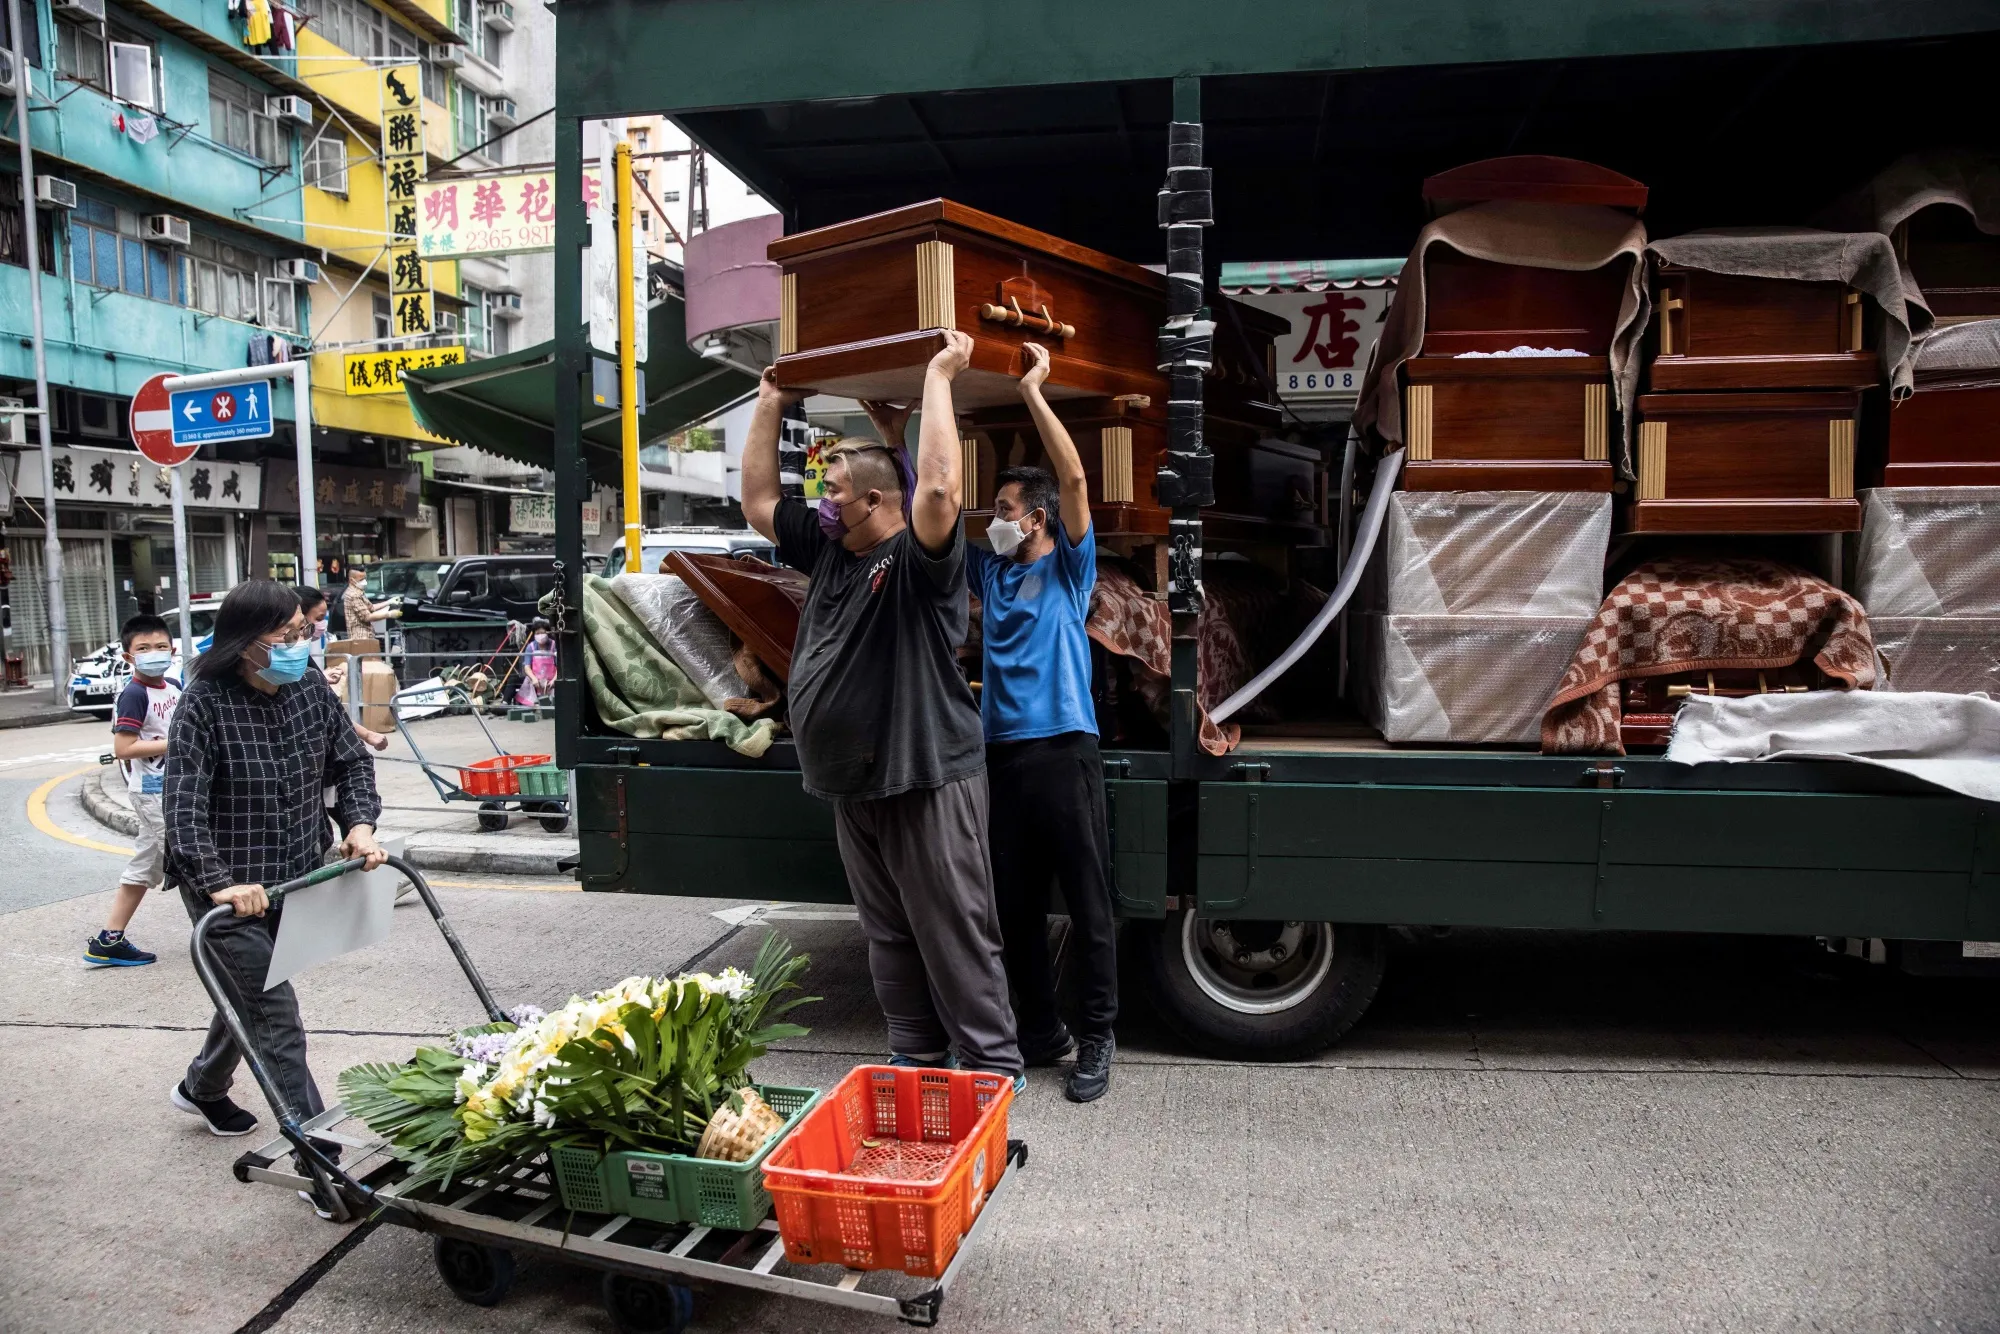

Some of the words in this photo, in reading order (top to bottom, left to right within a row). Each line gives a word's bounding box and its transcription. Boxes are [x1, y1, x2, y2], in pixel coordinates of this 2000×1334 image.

[466, 228, 512, 251] 2365
[1293, 292, 1366, 369] 店
[1289, 374, 1352, 389] 8608
[203, 429, 236, 439] approximately
[246, 426, 262, 434] metres
